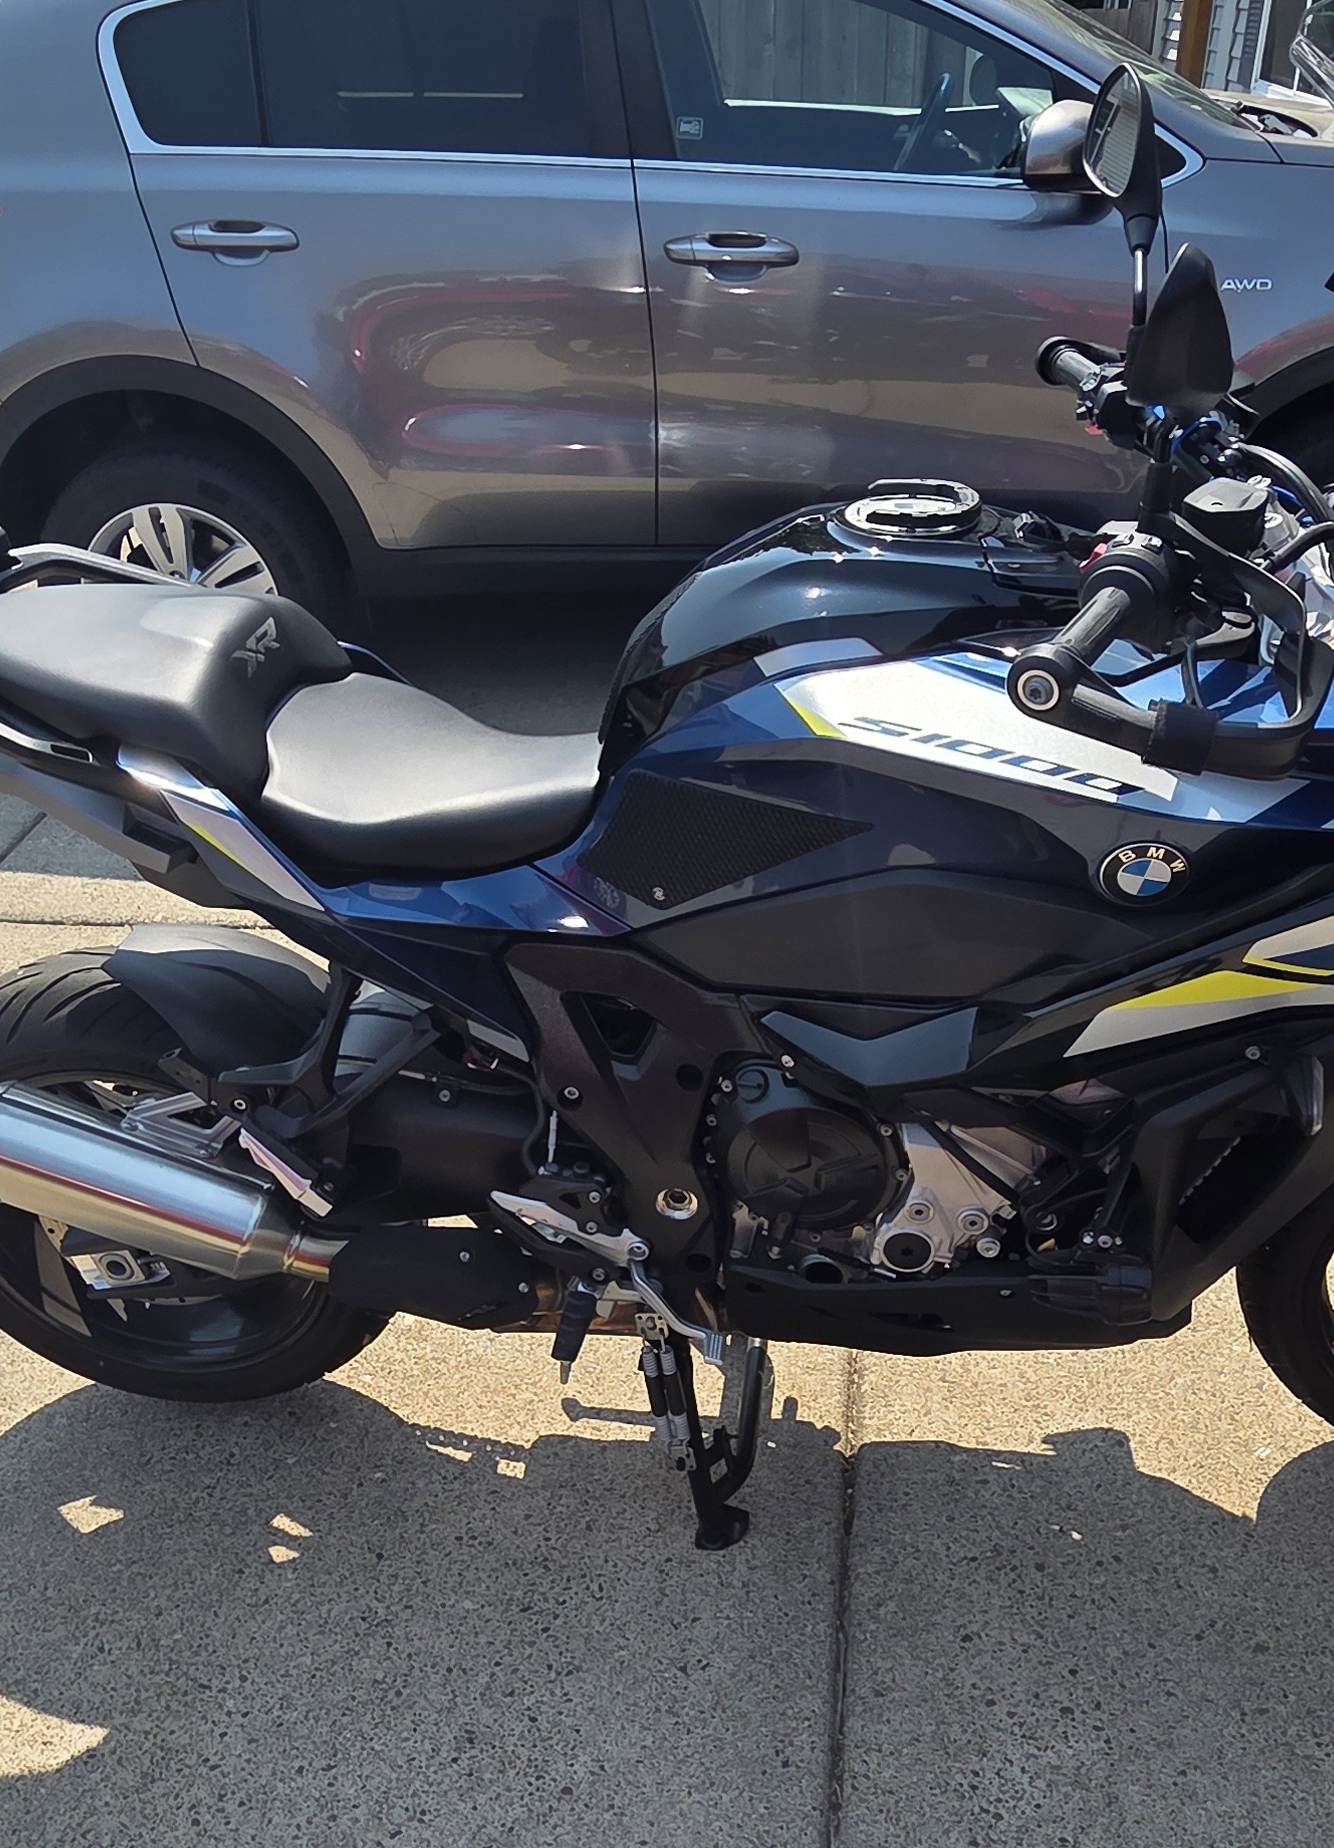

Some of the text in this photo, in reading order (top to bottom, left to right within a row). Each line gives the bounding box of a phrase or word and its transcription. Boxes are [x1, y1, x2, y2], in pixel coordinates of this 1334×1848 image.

[1220, 278, 1273, 291] AWD
[836, 715, 1146, 796] S1000
[1118, 846, 1188, 874] BMW
